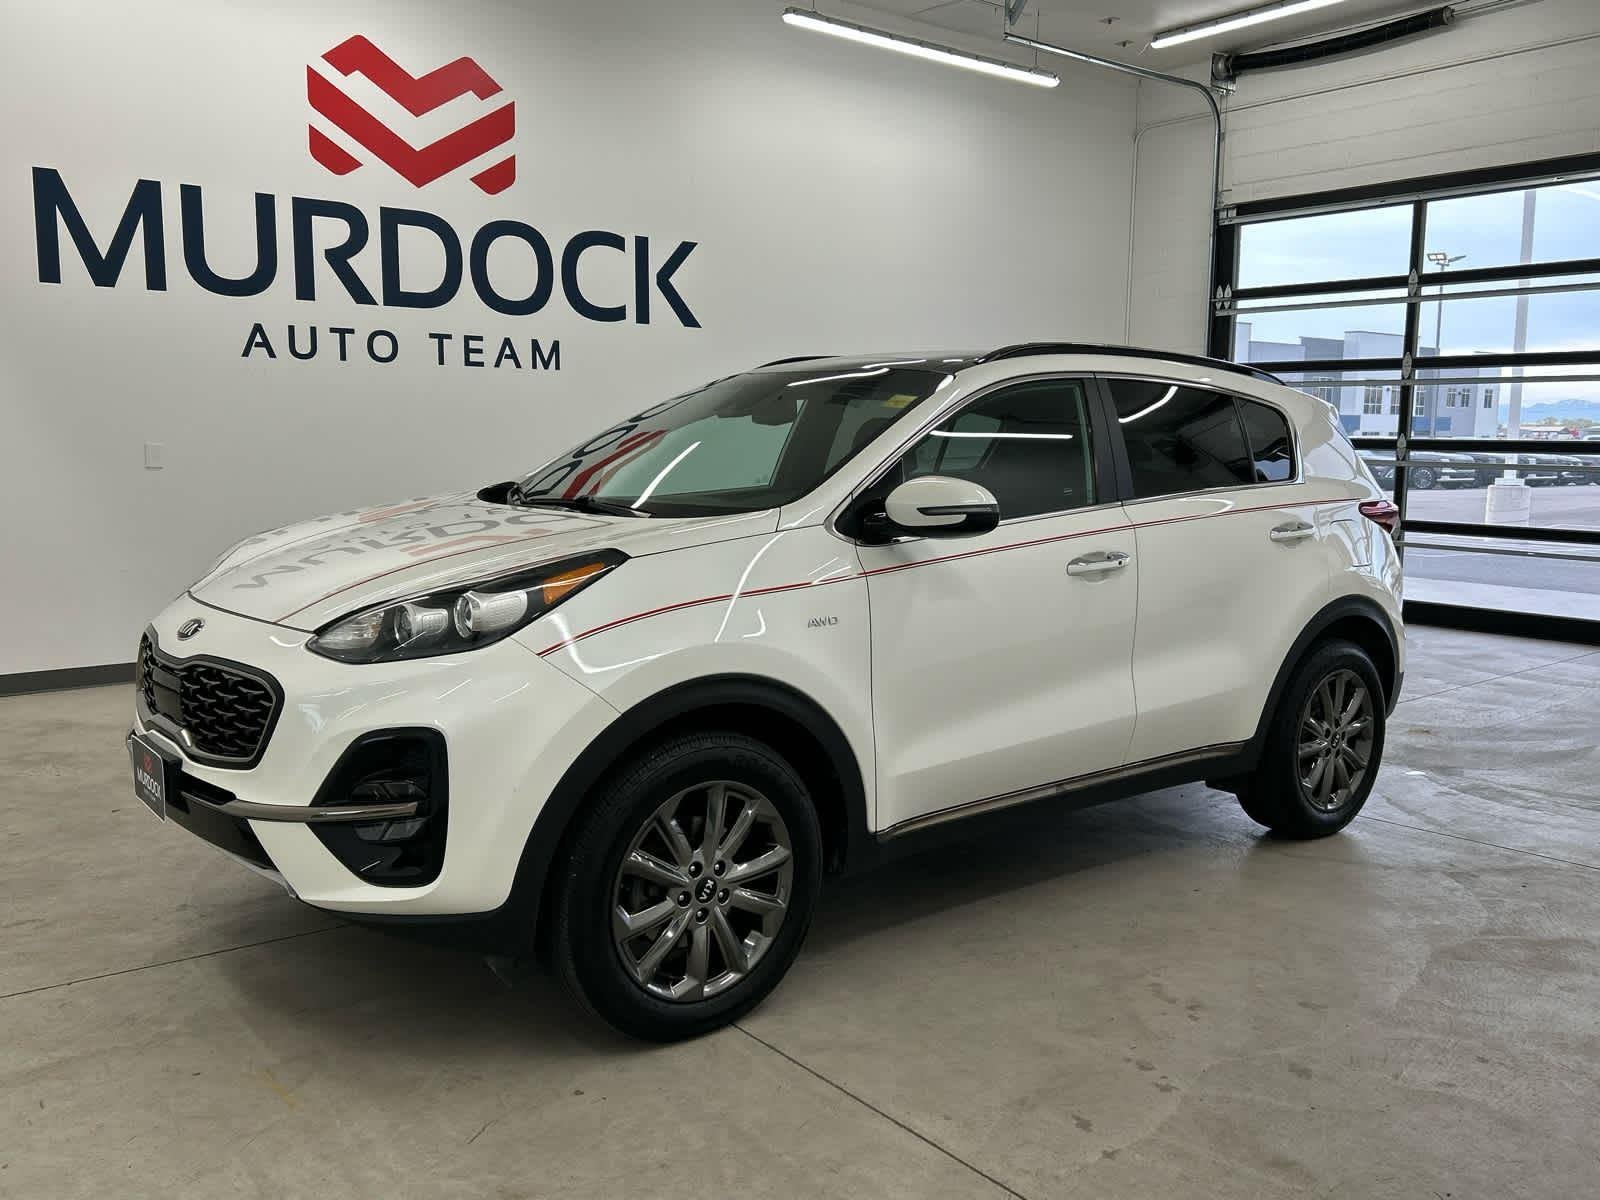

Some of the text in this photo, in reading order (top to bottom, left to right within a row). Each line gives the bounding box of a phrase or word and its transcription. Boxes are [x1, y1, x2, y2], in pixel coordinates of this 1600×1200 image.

[32, 167, 703, 329] MURDOCK
[241, 322, 562, 371] AUTO TEAM
[807, 615, 838, 629] AWD
[699, 879, 714, 900] KIA
